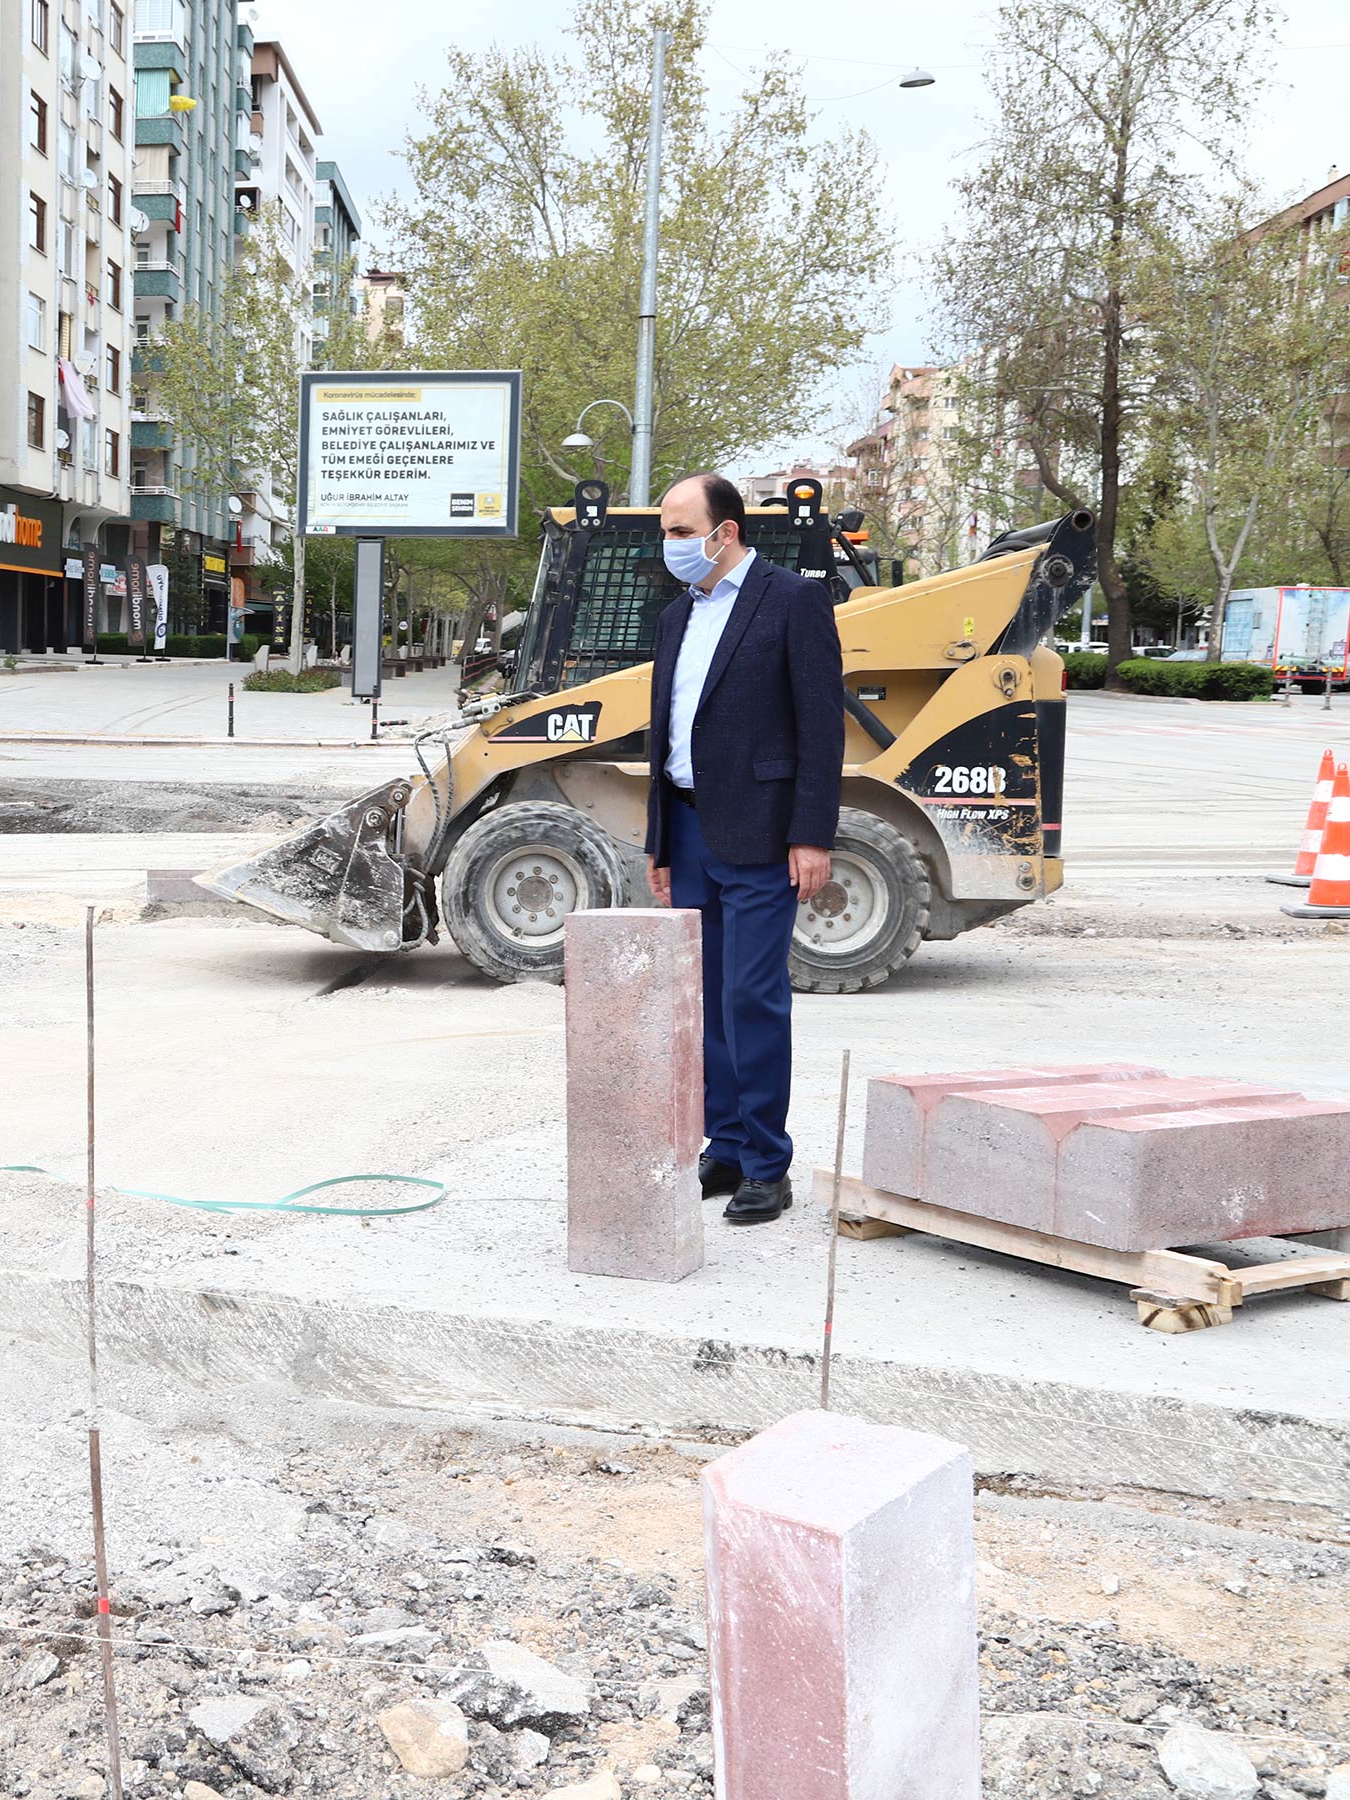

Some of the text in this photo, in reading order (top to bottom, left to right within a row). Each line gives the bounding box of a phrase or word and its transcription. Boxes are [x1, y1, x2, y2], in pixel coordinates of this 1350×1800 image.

[323, 391, 363, 399] Koronavirüs
[322, 409, 447, 423] SAĞLIK ÇALIŞANLARI,
[322, 424, 454, 437] EMNİYET GÖREVLİLERİ,
[321, 438, 495, 452] BELEDİYE ÇALIŞANLARIMIZ VE
[321, 453, 454, 467] TÜM EMEĞİ GEÇENLERE
[321, 467, 431, 481] TEŞEKKÜR EDERİM.
[320, 492, 409, 501] UĞUR İBRAHİM ALTAY
[547, 713, 594, 741] CAT
[934, 766, 1007, 794] 268B
[988, 809, 1010, 820] XPS
